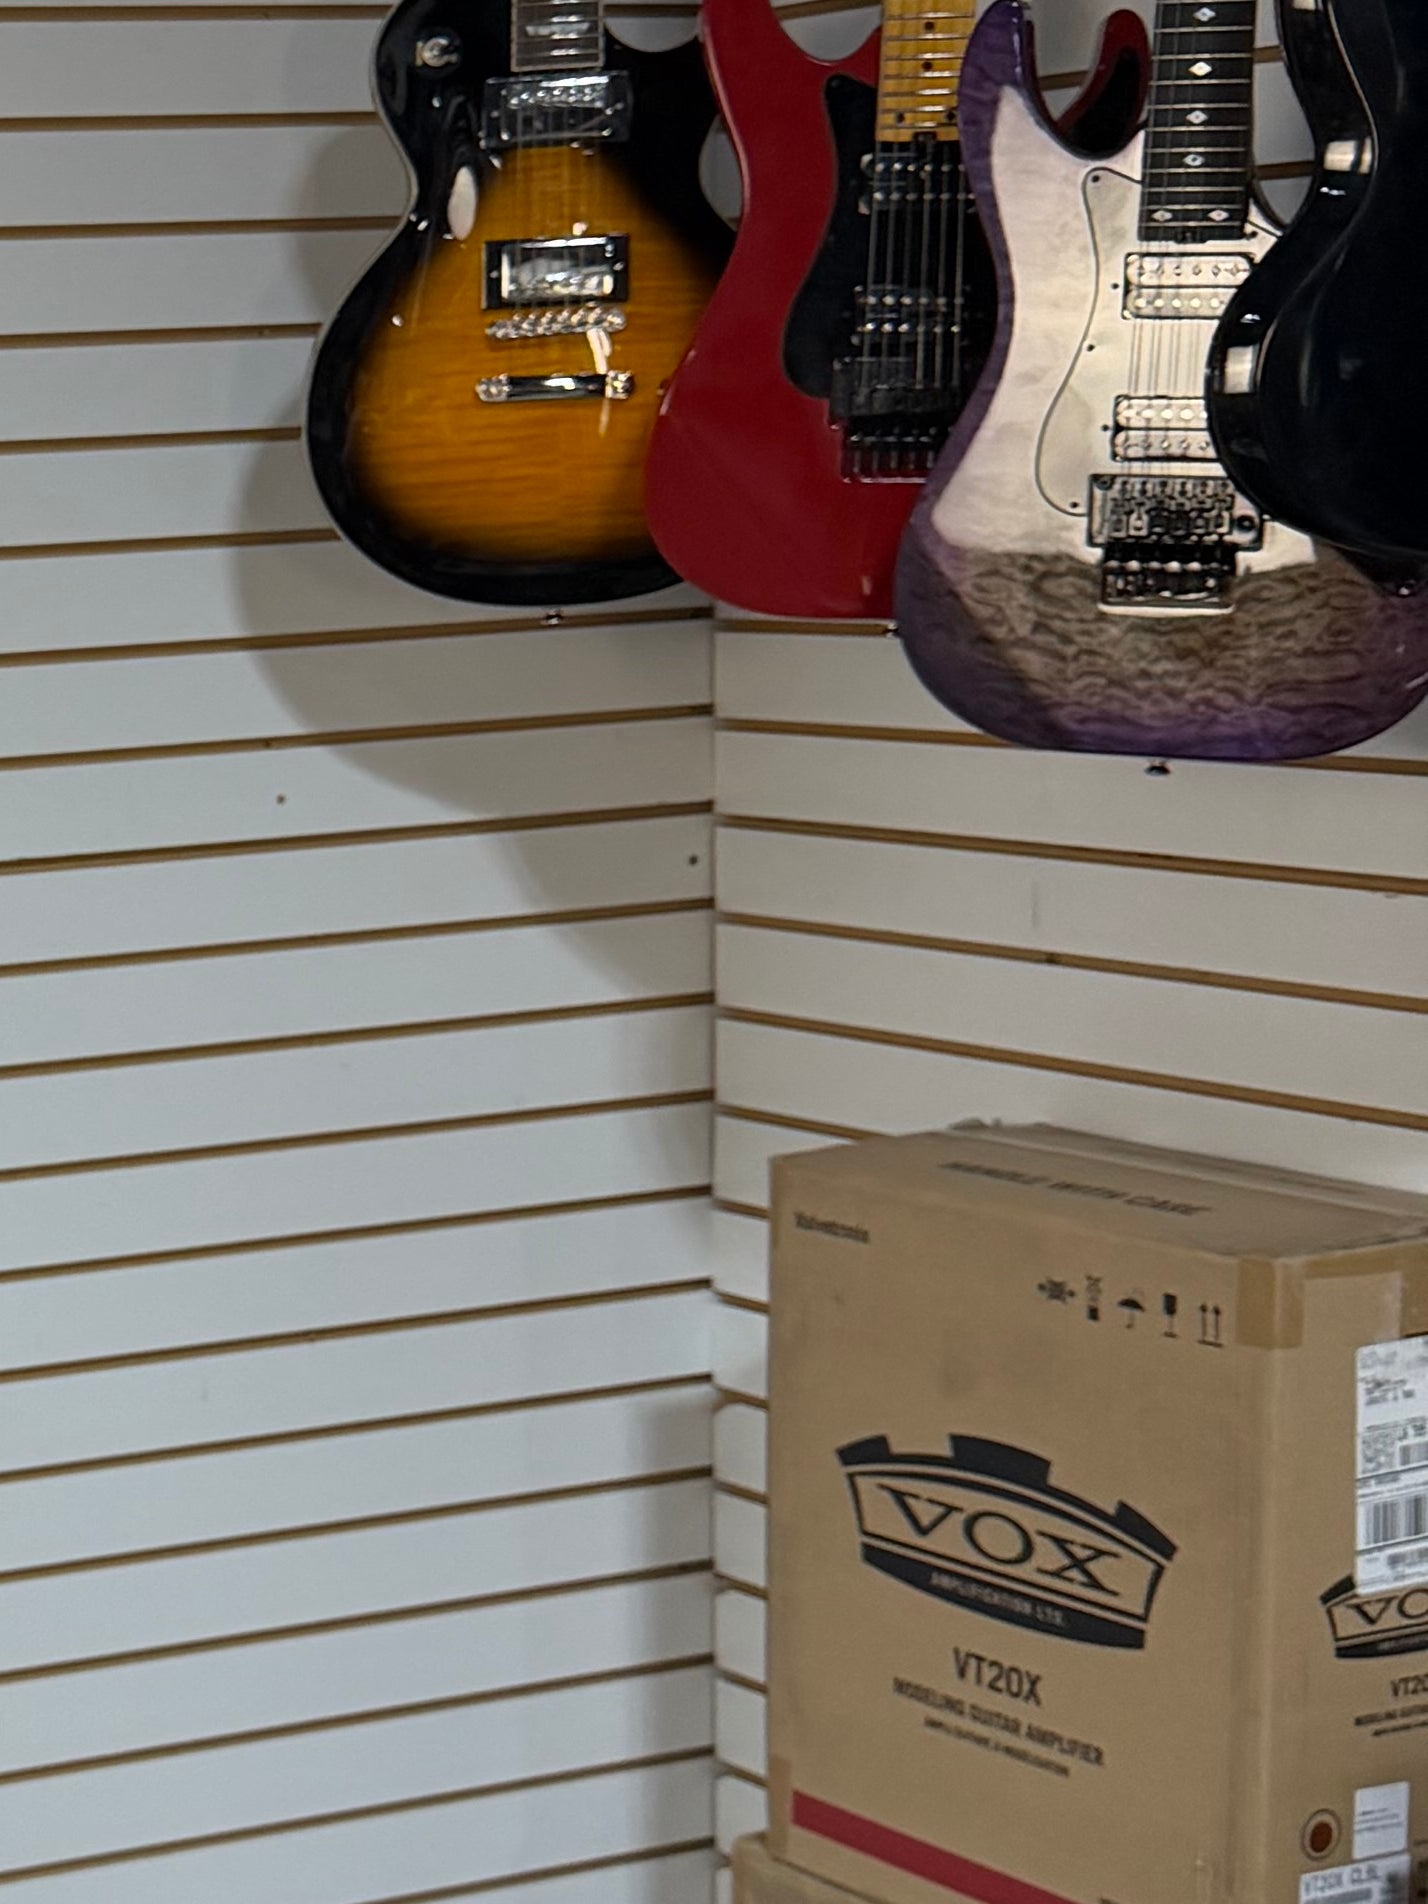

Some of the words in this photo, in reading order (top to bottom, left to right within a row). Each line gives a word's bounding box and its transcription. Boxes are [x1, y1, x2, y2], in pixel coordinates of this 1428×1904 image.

[876, 1481, 1124, 1599] VOX
[952, 1645, 1044, 1708] VT20X
[1025, 1723, 1105, 1767] AMPLIFIER
